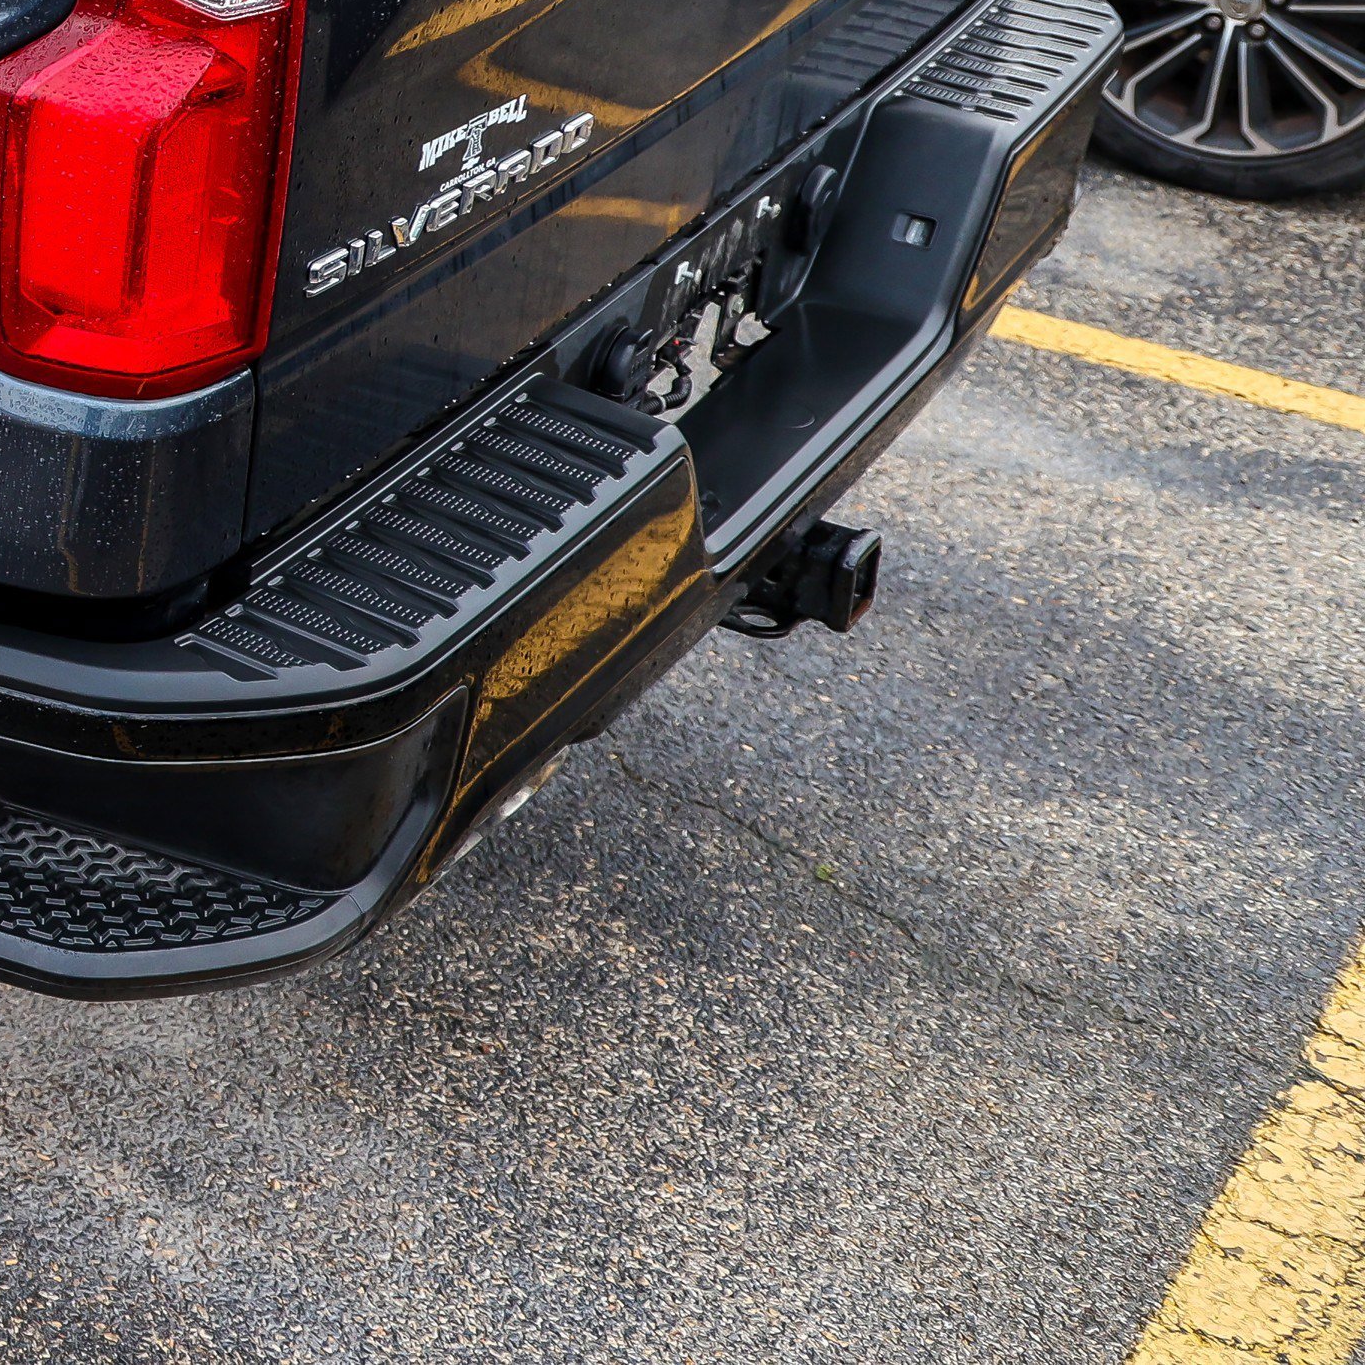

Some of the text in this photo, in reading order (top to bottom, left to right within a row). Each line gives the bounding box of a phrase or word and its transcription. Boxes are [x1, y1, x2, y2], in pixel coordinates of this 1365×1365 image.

[418, 124, 468, 172] MIKE
[487, 93, 528, 126] BELL
[486, 157, 496, 169] GA
[303, 112, 595, 298] SILVERADO
